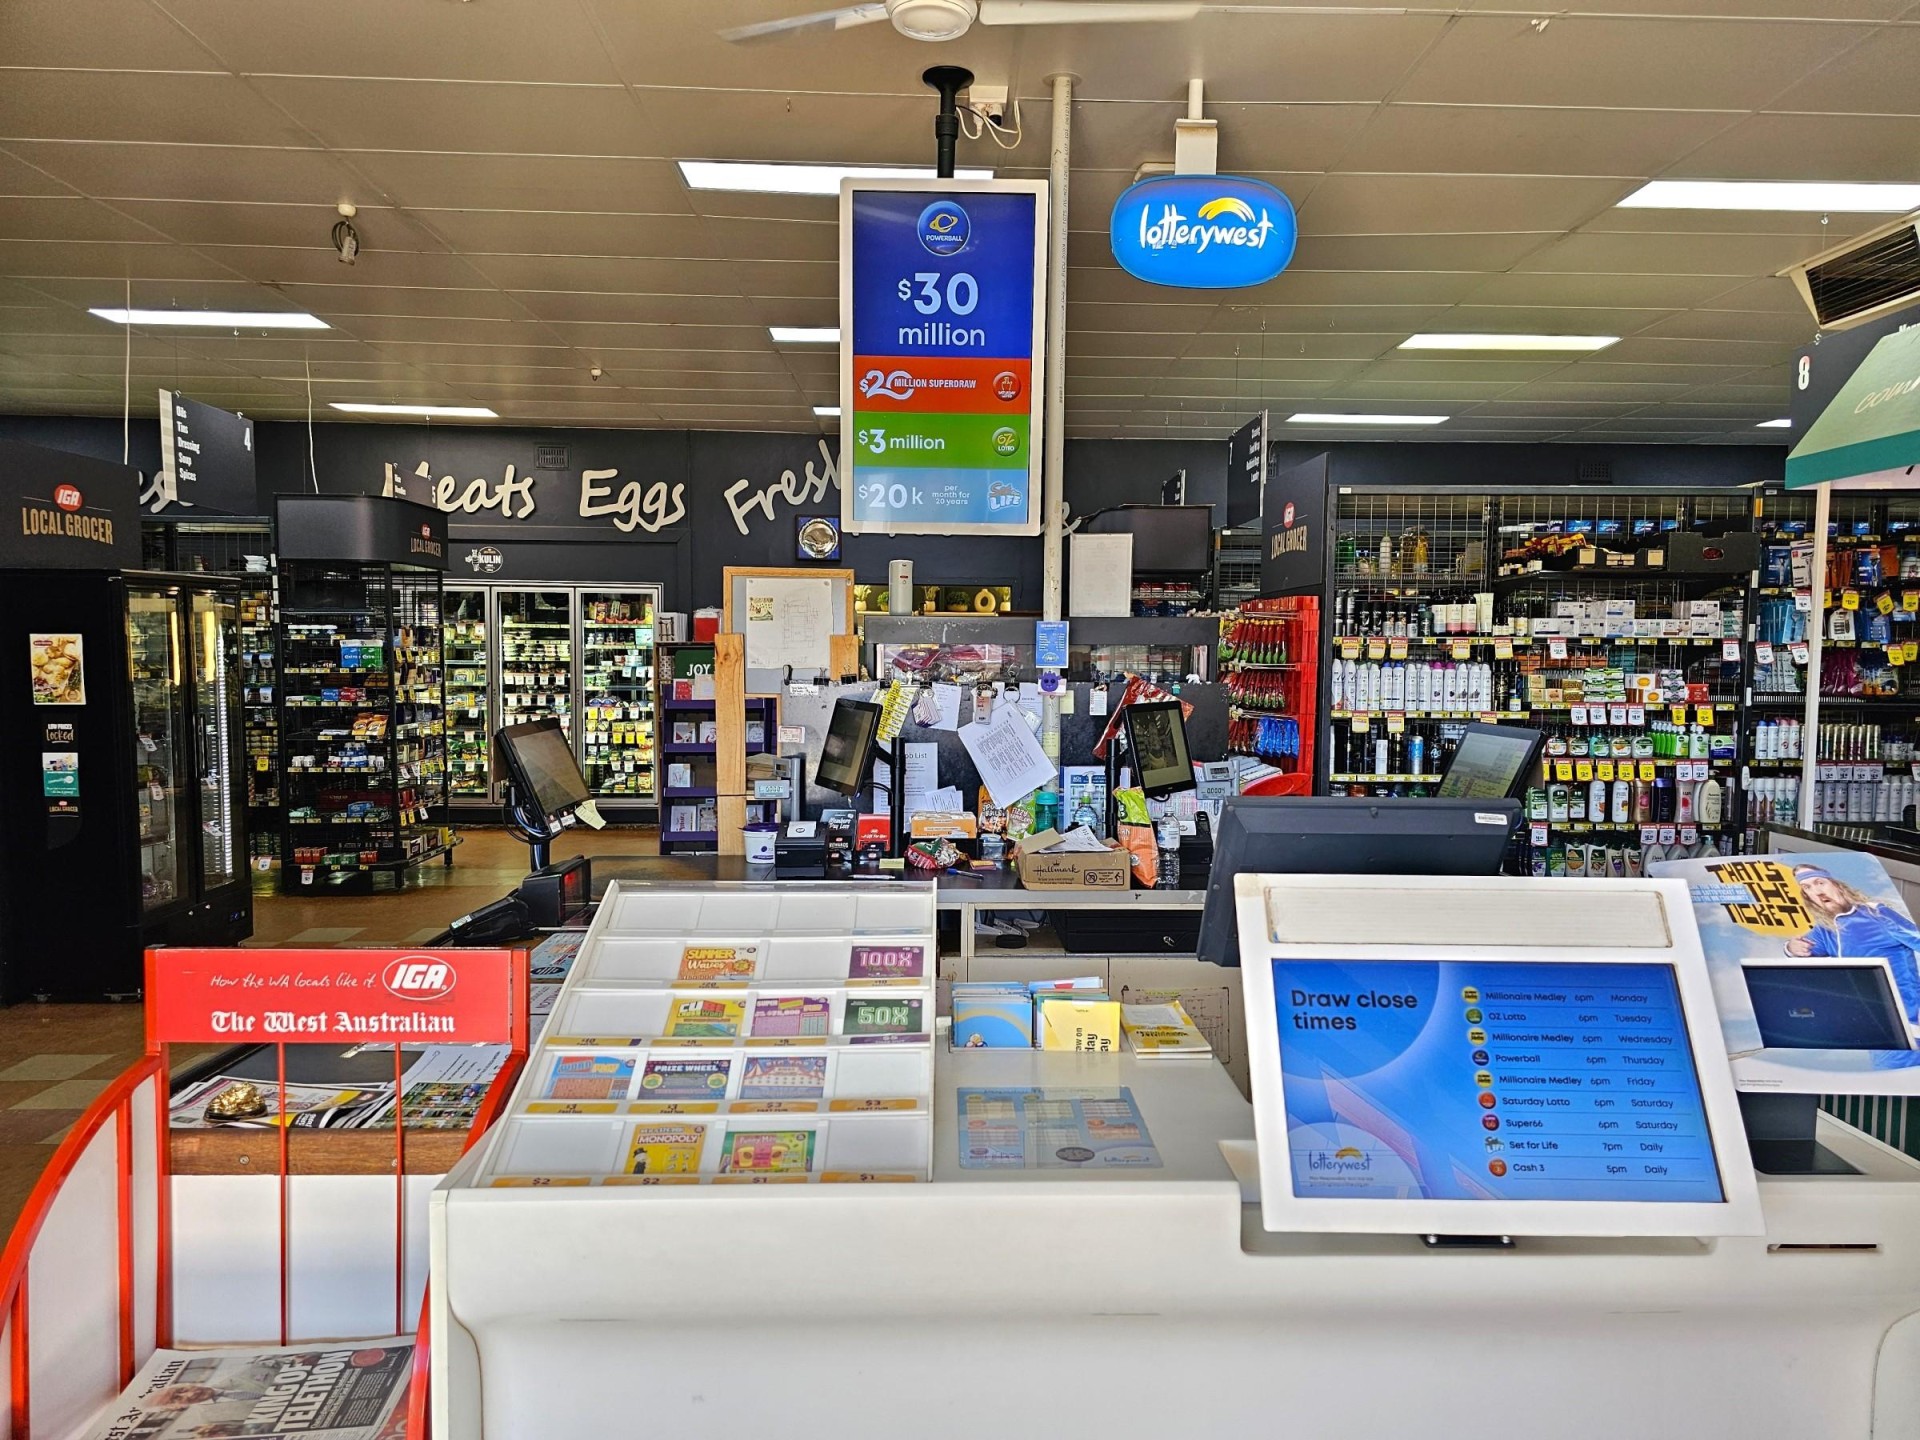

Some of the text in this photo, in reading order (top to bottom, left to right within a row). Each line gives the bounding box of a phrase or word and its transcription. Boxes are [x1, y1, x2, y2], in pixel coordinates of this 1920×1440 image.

[1140, 204, 1274, 254] lotterywest
[925, 234, 963, 242] POWERBALL
[898, 272, 979, 316] $30
[898, 323, 985, 346] million
[1798, 355, 1810, 391] 8
[859, 370, 977, 400] $20 MILLION SUPERDRAW
[176, 405, 187, 419] Oils
[176, 421, 189, 434] Tins
[177, 436, 201, 454] Dressing
[244, 427, 252, 452] 4
[858, 428, 945, 454] $3 million
[178, 451, 192, 467] Soup
[179, 468, 197, 482] Spices
[858, 484, 924, 509] $20 k
[932, 491, 970, 499] month for
[944, 485, 959, 493] per
[57, 488, 81, 506] IGA
[579, 468, 686, 533] Eggs
[945, 499, 969, 507] years
[990, 495, 1022, 510] LIFE
[21, 507, 114, 545] LOCAL GROCER
[410, 537, 442, 558] LOCAL GROCER
[1271, 525, 1308, 561] LOCAL GROCER
[480, 554, 501, 564] KULIN
[686, 663, 711, 677] JOY
[1032, 863, 1081, 877] Hallmark
[1704, 860, 1786, 883] THAT'S
[1743, 882, 1800, 905] THE
[1720, 903, 1815, 930] TICKET!
[686, 948, 736, 961] SUMMER
[859, 951, 913, 968] 100X
[687, 960, 726, 970] Waves
[210, 975, 240, 987] How
[242, 972, 265, 988] the
[268, 976, 290, 988] WA
[294, 972, 331, 988] locals
[335, 972, 358, 987] like
[391, 964, 448, 989] IGA
[1291, 989, 1418, 1009] Draw close
[1485, 992, 1648, 1004] Millionaire Medley 6pm Monday
[211, 1011, 456, 1033] The West Australian
[857, 1006, 910, 1027] 50X
[1292, 1011, 1357, 1031] times
[1488, 1013, 1653, 1025] OZ Lotto 6pm Tuesday
[1492, 1033, 1673, 1045] Millionaire Medley 6pm Wednesday
[1495, 1054, 1665, 1066] Powerball 6pm Thursday
[654, 1064, 719, 1072] PRIZE WHEEL
[1499, 1075, 1656, 1087] Millionaire Medley 6pm Friday
[1502, 1097, 1674, 1109] Saturday Lotto 6pm Saturday
[1505, 1119, 1678, 1131] Super66 6pm Saturday
[637, 1134, 699, 1145] MONOPOLY
[1509, 1141, 1664, 1153] Set for Life 7pm Daily
[1308, 1150, 1373, 1174] lotterywest
[1513, 1163, 1668, 1175] Cash 3 5pm Daily
[532, 1177, 551, 1186] $2
[642, 1177, 660, 1186] $2
[752, 1176, 768, 1184] $1
[860, 1173, 875, 1181] $1
[243, 1361, 312, 1425] KING OF
[272, 1349, 354, 1433] TELETHON
